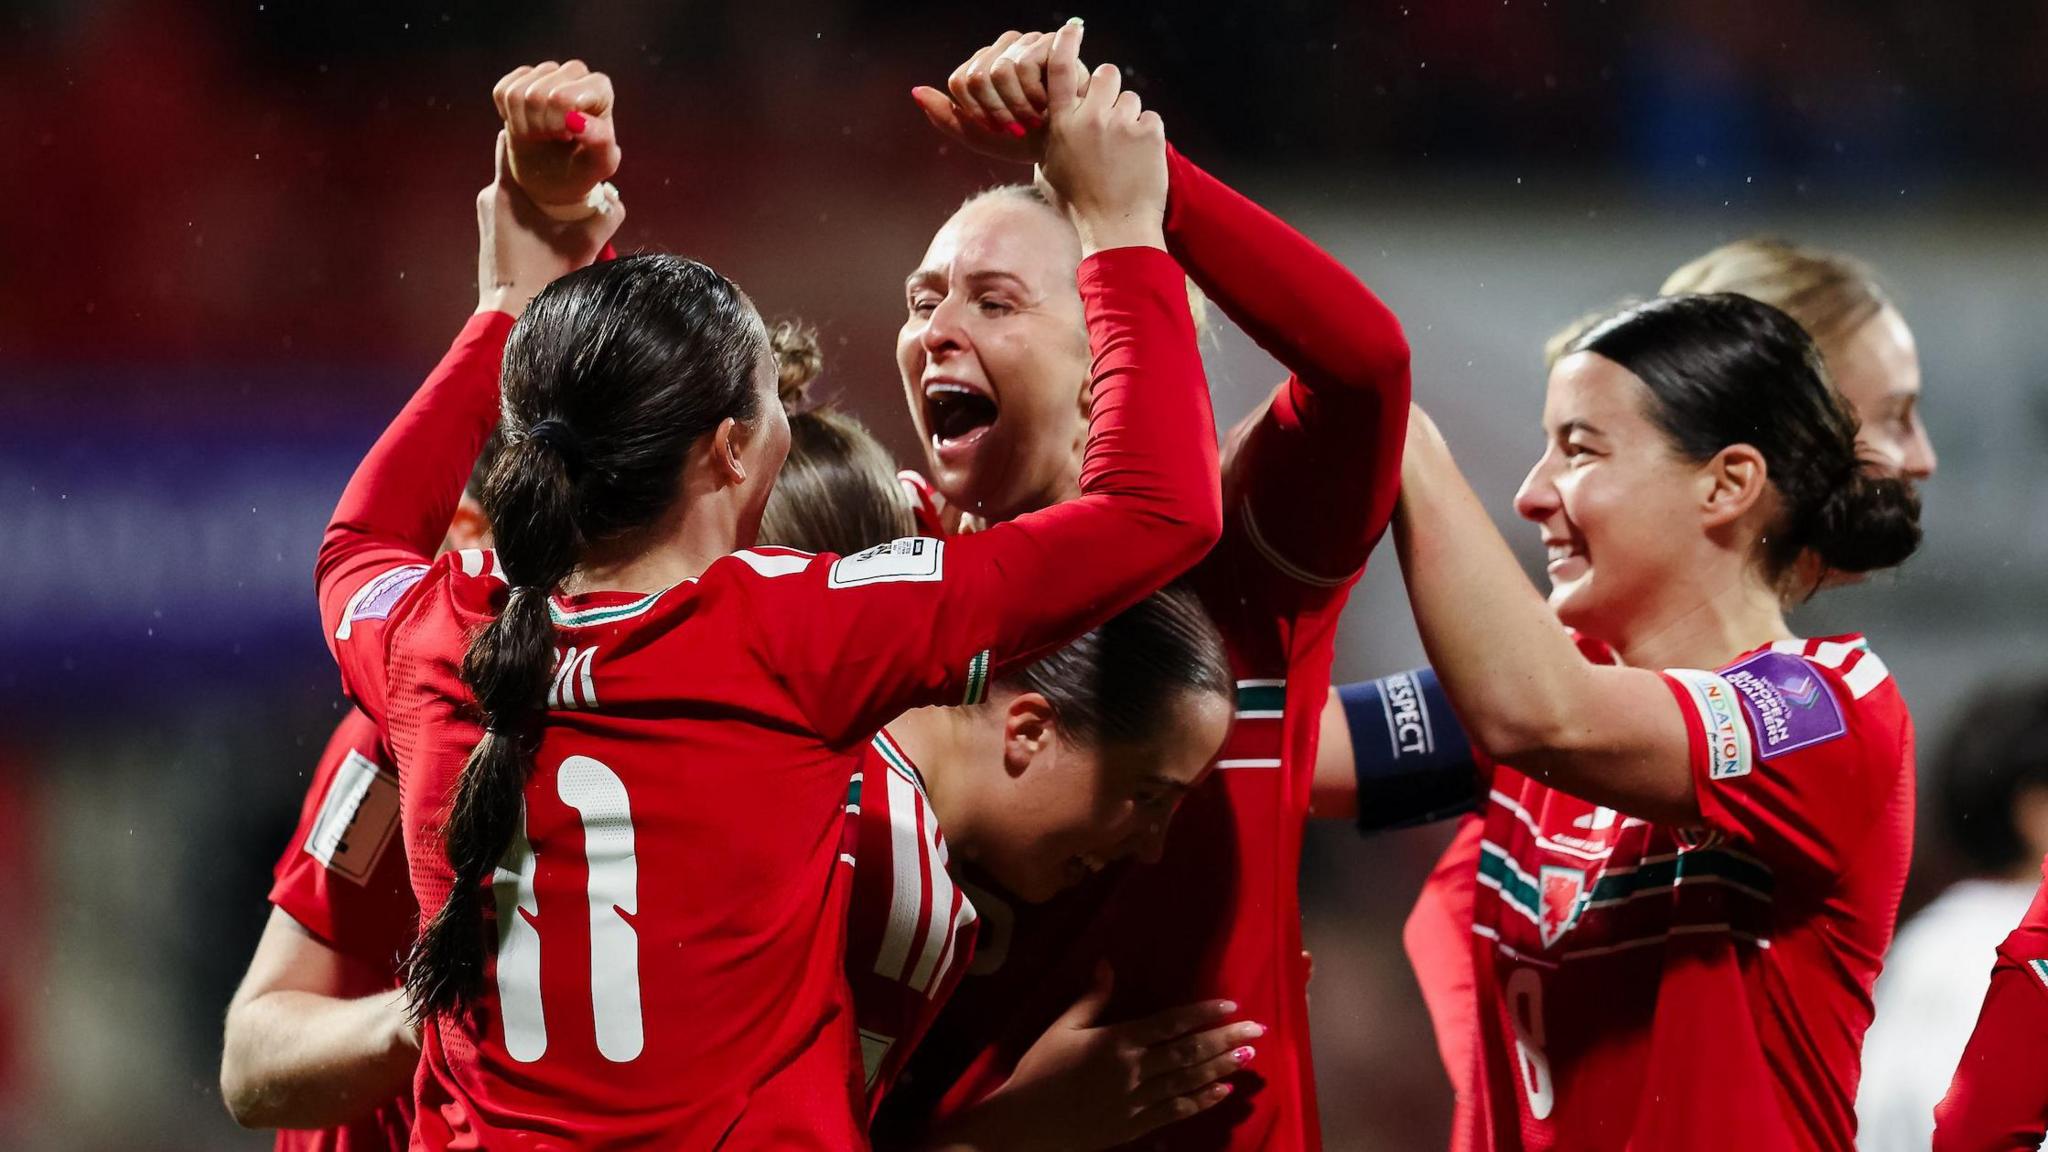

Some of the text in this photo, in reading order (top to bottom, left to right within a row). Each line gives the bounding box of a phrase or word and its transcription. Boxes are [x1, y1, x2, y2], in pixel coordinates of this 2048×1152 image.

[1727, 674, 1779, 745] QUALIFIERS
[1735, 670, 1789, 740] EUROPEAN
[492, 755, 645, 1063] 11
[1506, 967, 1554, 1120] 8
